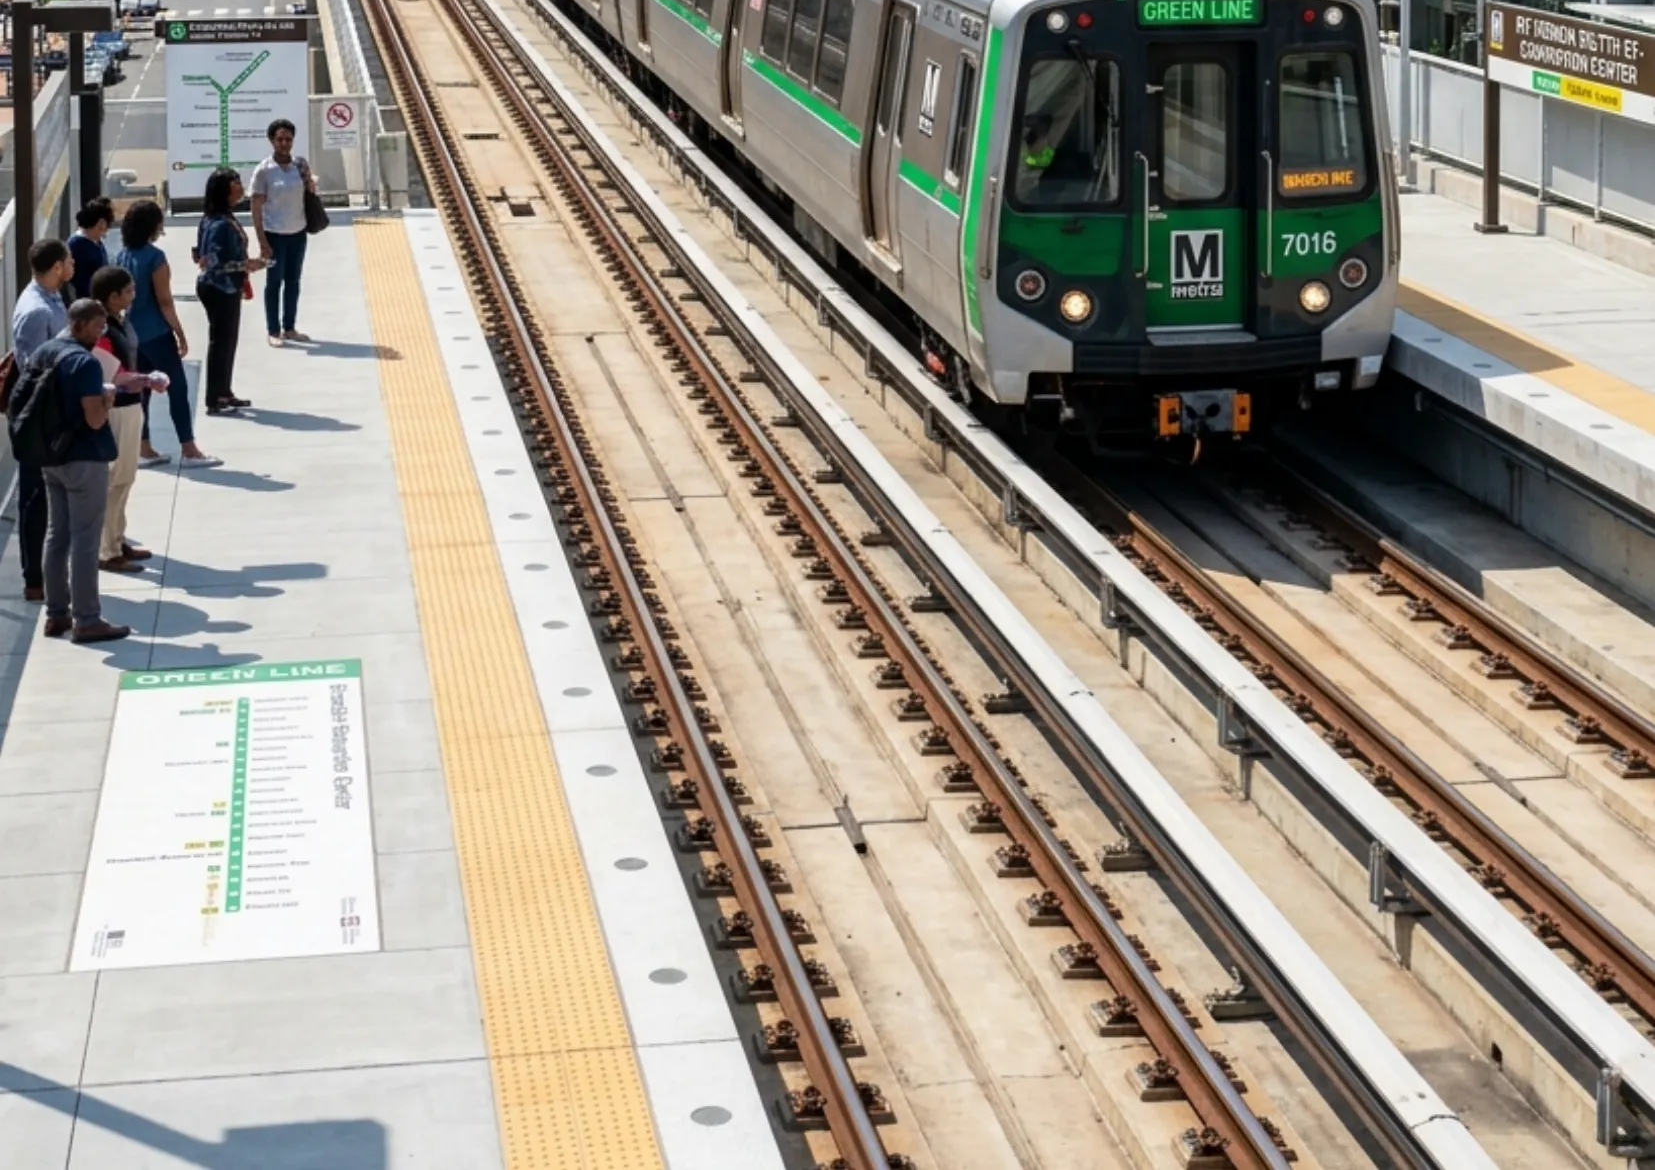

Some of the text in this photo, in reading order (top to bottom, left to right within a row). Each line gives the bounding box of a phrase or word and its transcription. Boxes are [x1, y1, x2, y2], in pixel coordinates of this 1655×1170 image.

[1144, 0, 1204, 20] GREEN
[1281, 231, 1337, 256] 7016
[1175, 234, 1219, 279] M
